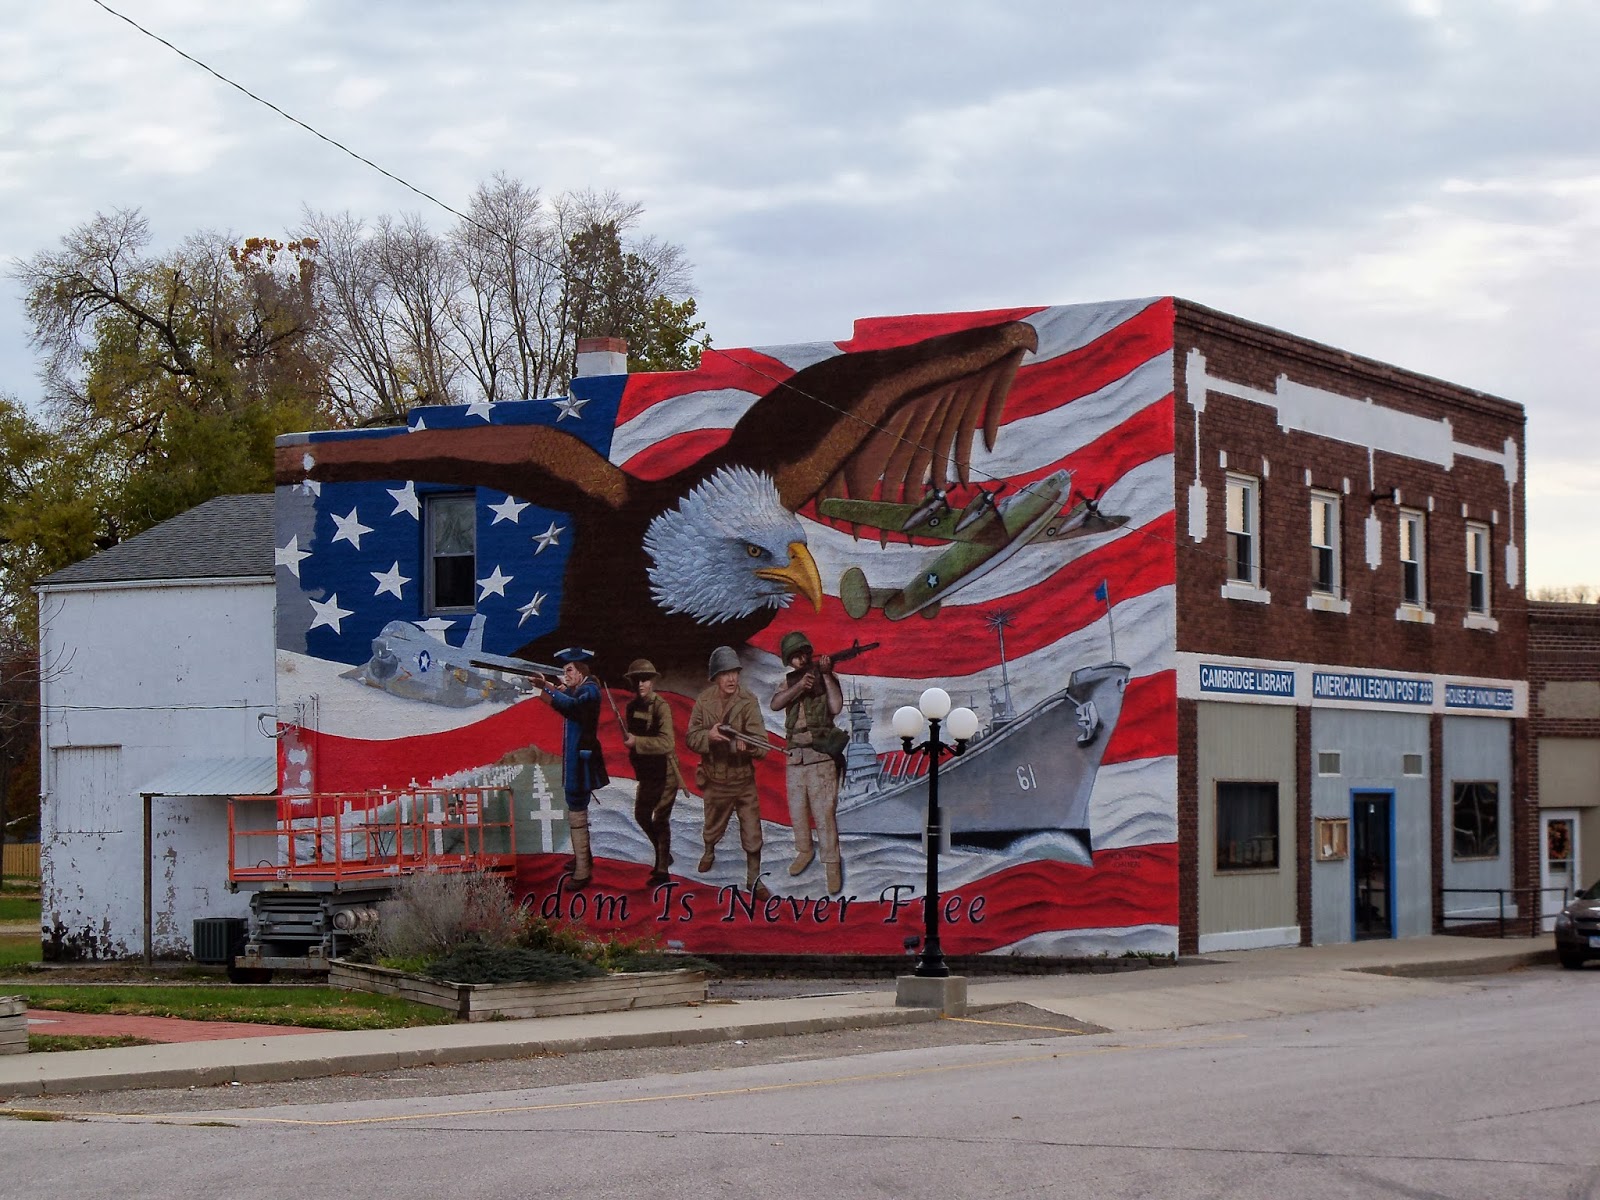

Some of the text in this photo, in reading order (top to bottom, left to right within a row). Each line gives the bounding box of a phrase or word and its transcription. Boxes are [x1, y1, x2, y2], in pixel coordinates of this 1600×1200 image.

[1201, 668, 1292, 693] CAMBRIDGE LIBRARY
[1314, 675, 1362, 697] AMERICAN
[1363, 679, 1395, 699] LEGION
[1396, 681, 1418, 701] POST
[1446, 688, 1466, 704] HOUSE
[1467, 689, 1476, 705] OF
[1016, 763, 1037, 791] 61
[654, 881, 694, 922] Is
[718, 872, 857, 923] Never
